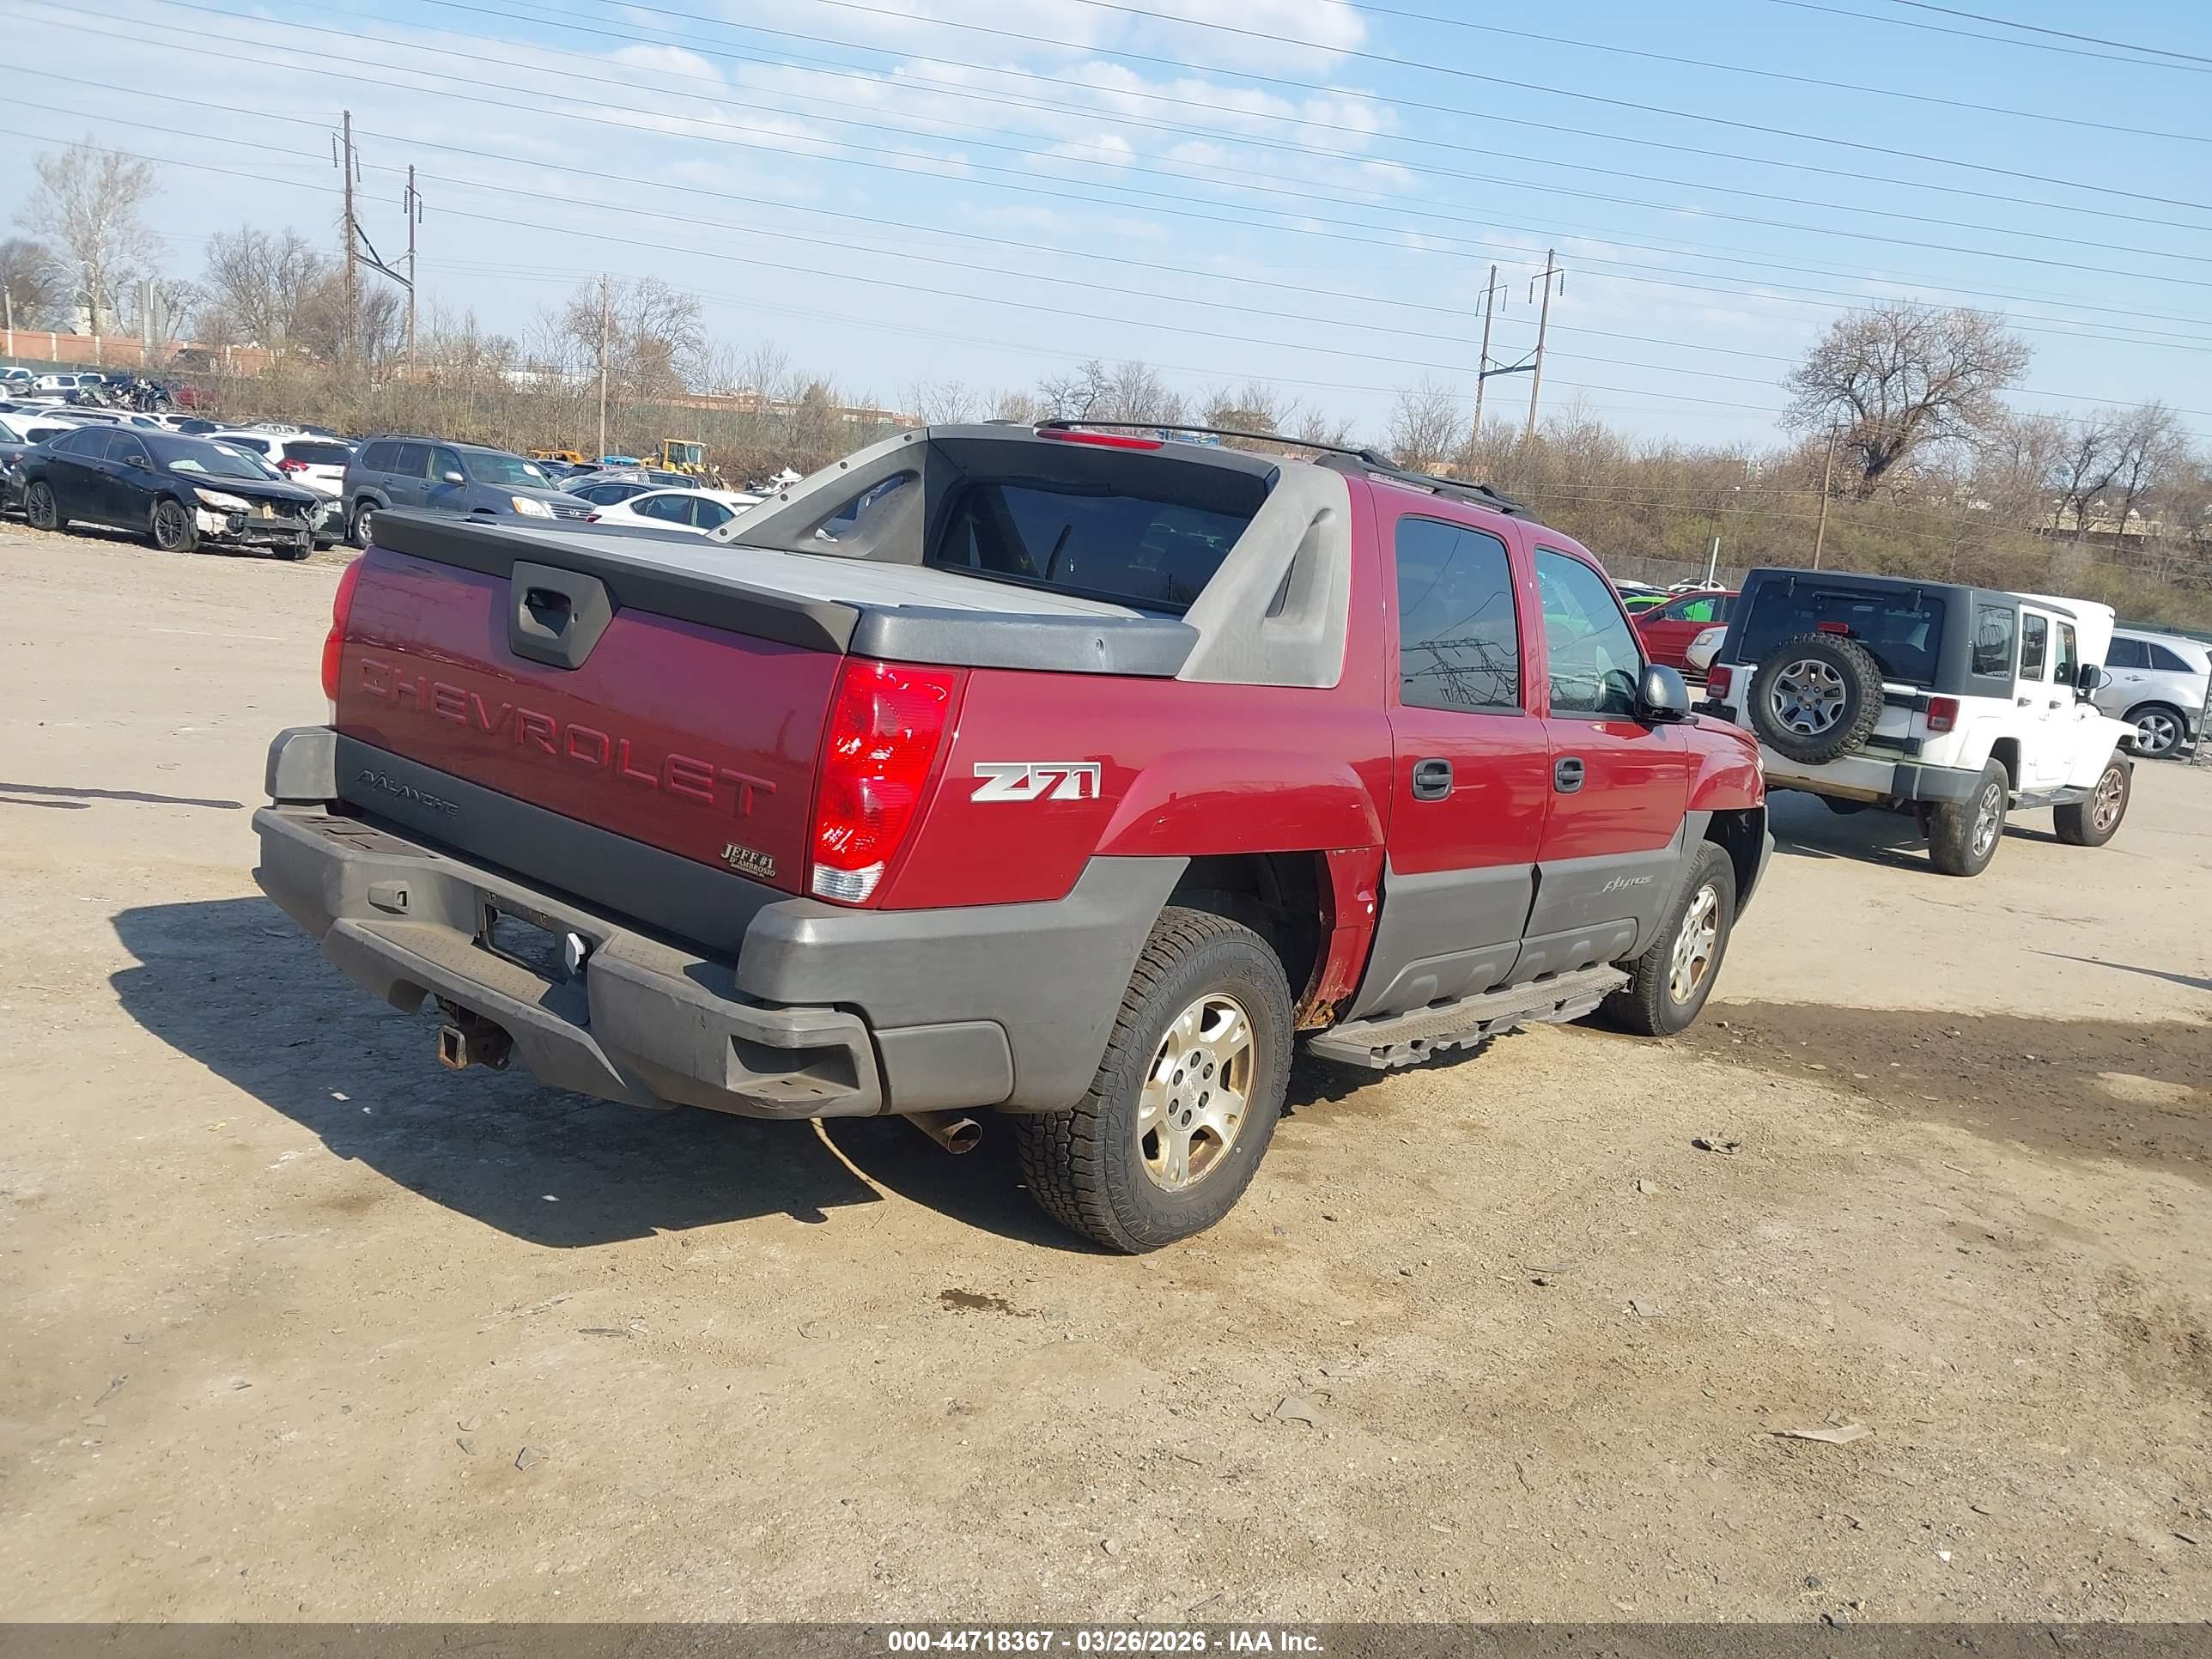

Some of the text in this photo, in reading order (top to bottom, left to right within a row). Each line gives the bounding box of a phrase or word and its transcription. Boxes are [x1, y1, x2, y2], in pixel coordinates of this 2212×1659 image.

[361, 658, 777, 817] CHEVROLET
[355, 769, 460, 818] AVALANCHE
[970, 762, 1102, 803] Z71
[720, 843, 775, 869] JEFF #1
